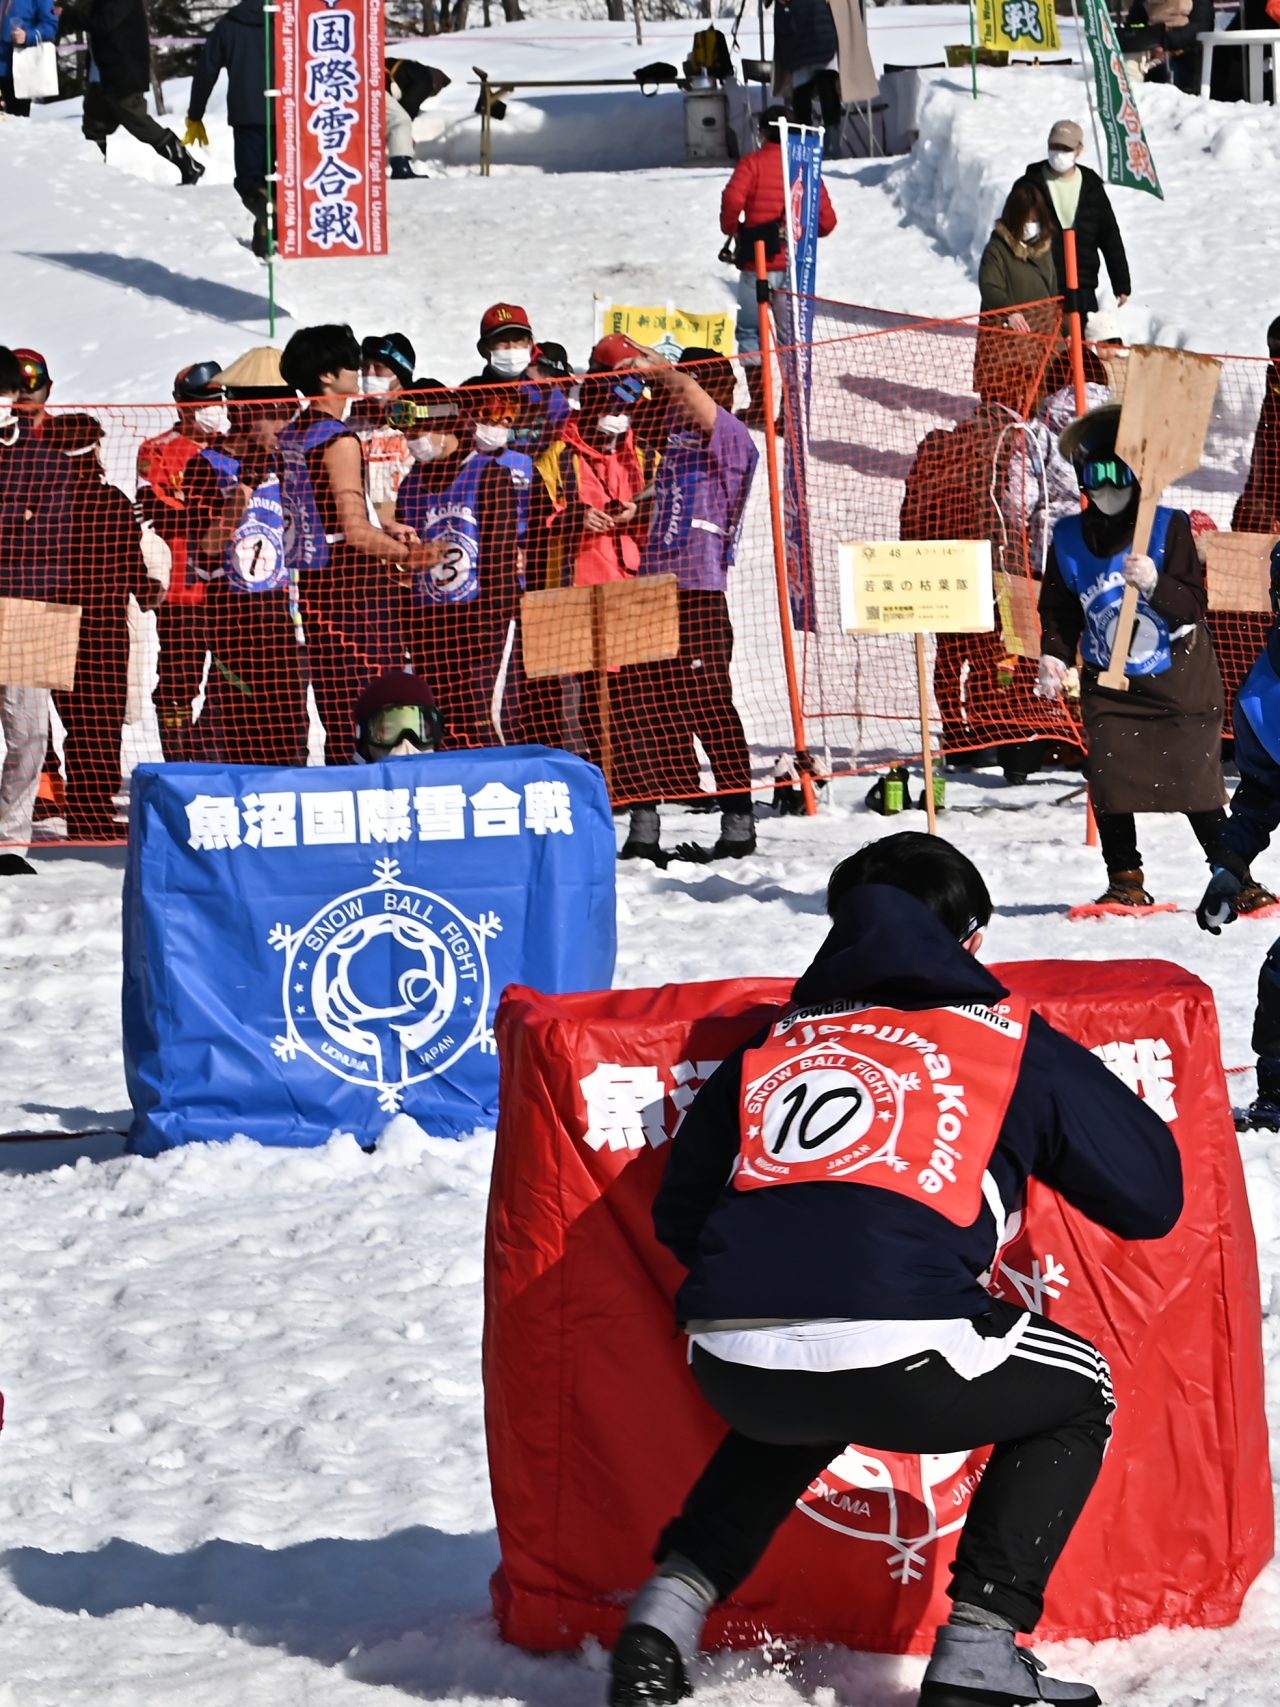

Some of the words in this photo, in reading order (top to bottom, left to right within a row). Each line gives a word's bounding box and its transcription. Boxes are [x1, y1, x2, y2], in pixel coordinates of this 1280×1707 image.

[282, 1, 295, 34] Fight
[1001, 0, 1044, 43] 戦
[282, 38, 295, 95] Snowball
[1096, 38, 1112, 120] Championship
[304, 9, 363, 250] 国際雪合戦
[370, 90, 382, 147] Snowball
[283, 98, 296, 187] Championship
[1107, 121, 1119, 156] World
[370, 150, 382, 182] Fight
[1110, 159, 1120, 179] The
[284, 190, 296, 227] World
[372, 185, 382, 198] in
[285, 229, 296, 254] The
[372, 201, 383, 252] Uonuma
[713, 319, 725, 346] The
[249, 539, 263, 576] 1
[434, 548, 463, 586] 3
[865, 578, 968, 592] 若葉の枯葉隊
[185, 780, 574, 850] 魚沼国際雪合戦
[304, 898, 364, 952] SNOW
[383, 892, 434, 925] BALL
[439, 921, 478, 983] FIGHT
[319, 1041, 370, 1073] UONUMA
[419, 1034, 455, 1066] JAPAN
[747, 1067, 794, 1115] SNOW
[799, 1055, 847, 1070] BALL
[851, 1061, 894, 1104] FIGHT
[770, 1082, 862, 1155] 10
[825, 1144, 871, 1171] JAPAN
[808, 1477, 871, 1518] ONUMA
